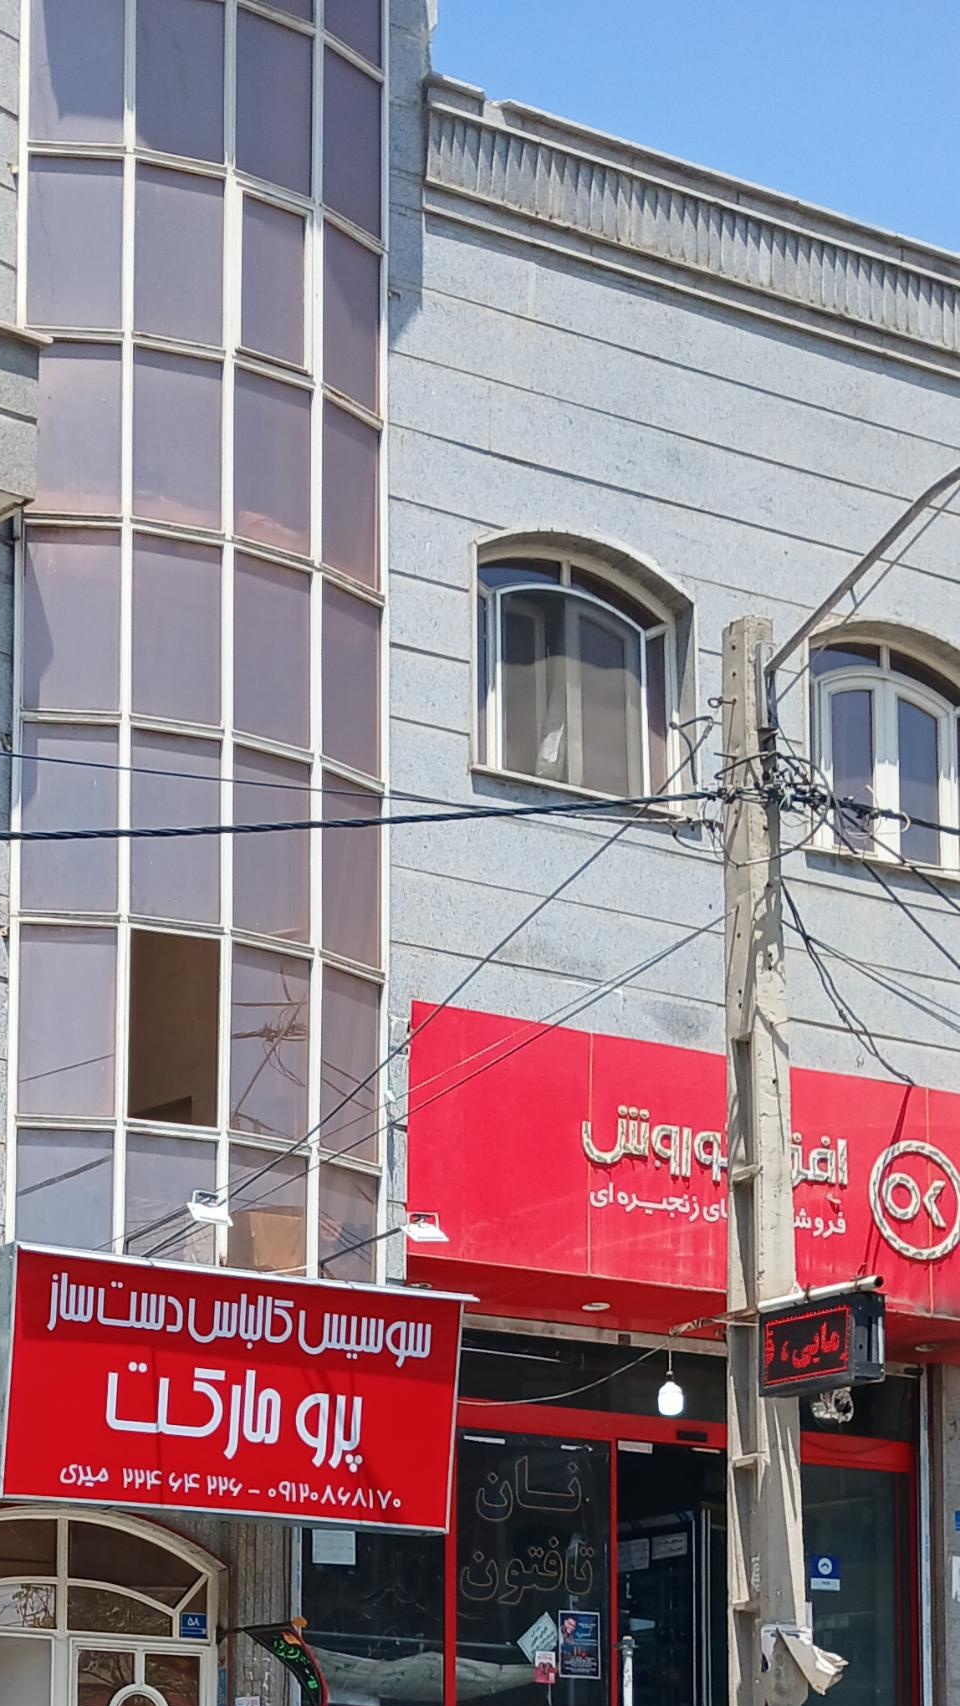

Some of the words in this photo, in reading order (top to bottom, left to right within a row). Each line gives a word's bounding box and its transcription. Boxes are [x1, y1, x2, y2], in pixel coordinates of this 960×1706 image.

[581, 1104, 730, 1183] وروش
[589, 1181, 615, 1208] ای
[616, 1190, 700, 1220] زنجیره
[882, 1172, 947, 1228] OK
[187, 1293, 295, 1350] کالباس
[297, 1309, 432, 1369] سوسیس
[105, 1361, 281, 1460] مارکت
[295, 1392, 363, 1472] پرو
[476, 1455, 582, 1522] نان
[459, 1535, 595, 1605] تافتون
